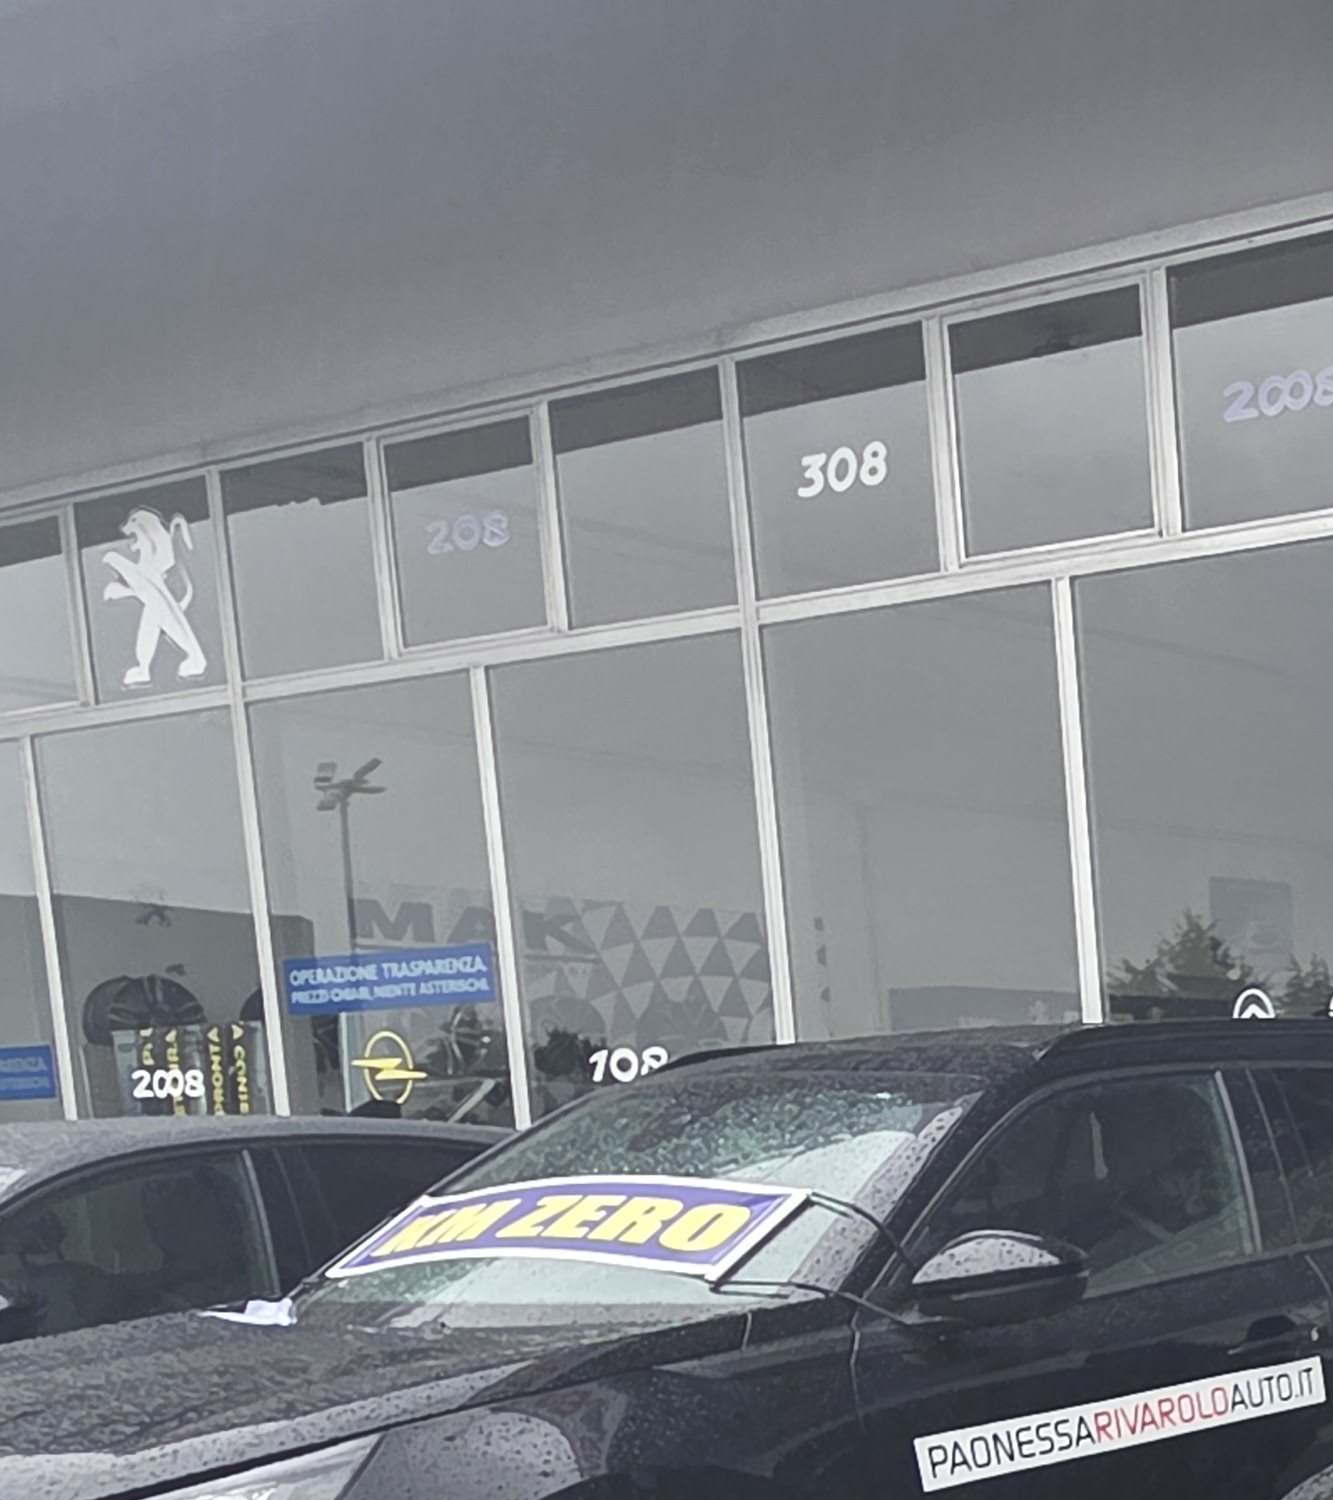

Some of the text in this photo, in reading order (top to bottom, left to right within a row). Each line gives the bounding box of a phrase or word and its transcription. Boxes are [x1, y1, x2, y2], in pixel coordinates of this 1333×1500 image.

[798, 441, 887, 498] 308
[426, 513, 509, 555] 208
[290, 963, 378, 986] OPERAZIONE
[132, 1069, 205, 1099] 2008
[370, 1194, 751, 1258] KM ZERO
[926, 1367, 1314, 1479] PAONESSARIVAROLOAUTO.IT
